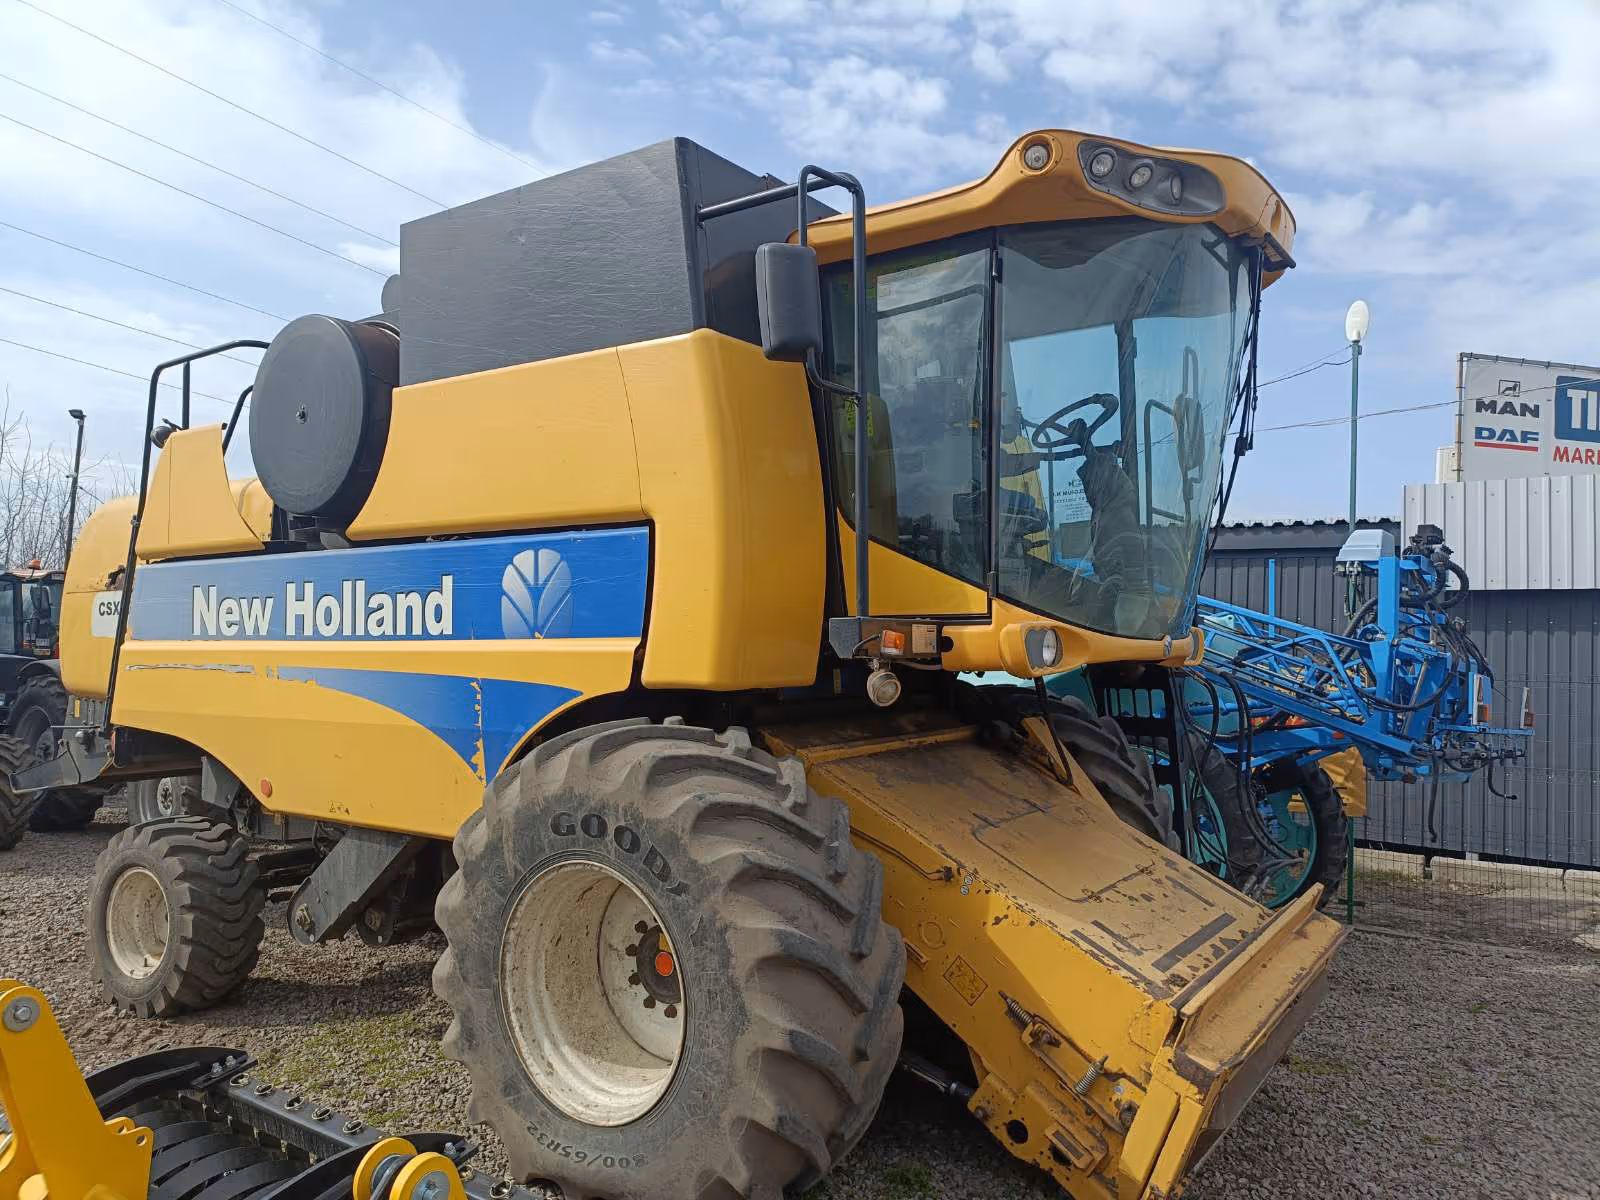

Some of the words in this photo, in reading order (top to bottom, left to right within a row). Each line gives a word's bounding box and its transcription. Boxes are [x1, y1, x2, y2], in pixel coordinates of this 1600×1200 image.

[1475, 399, 1540, 418] MAN
[1567, 388, 1600, 432] TI
[1474, 426, 1540, 443] DAF
[98, 600, 121, 616] CSX
[192, 584, 274, 637] New
[285, 573, 454, 638] Holland
